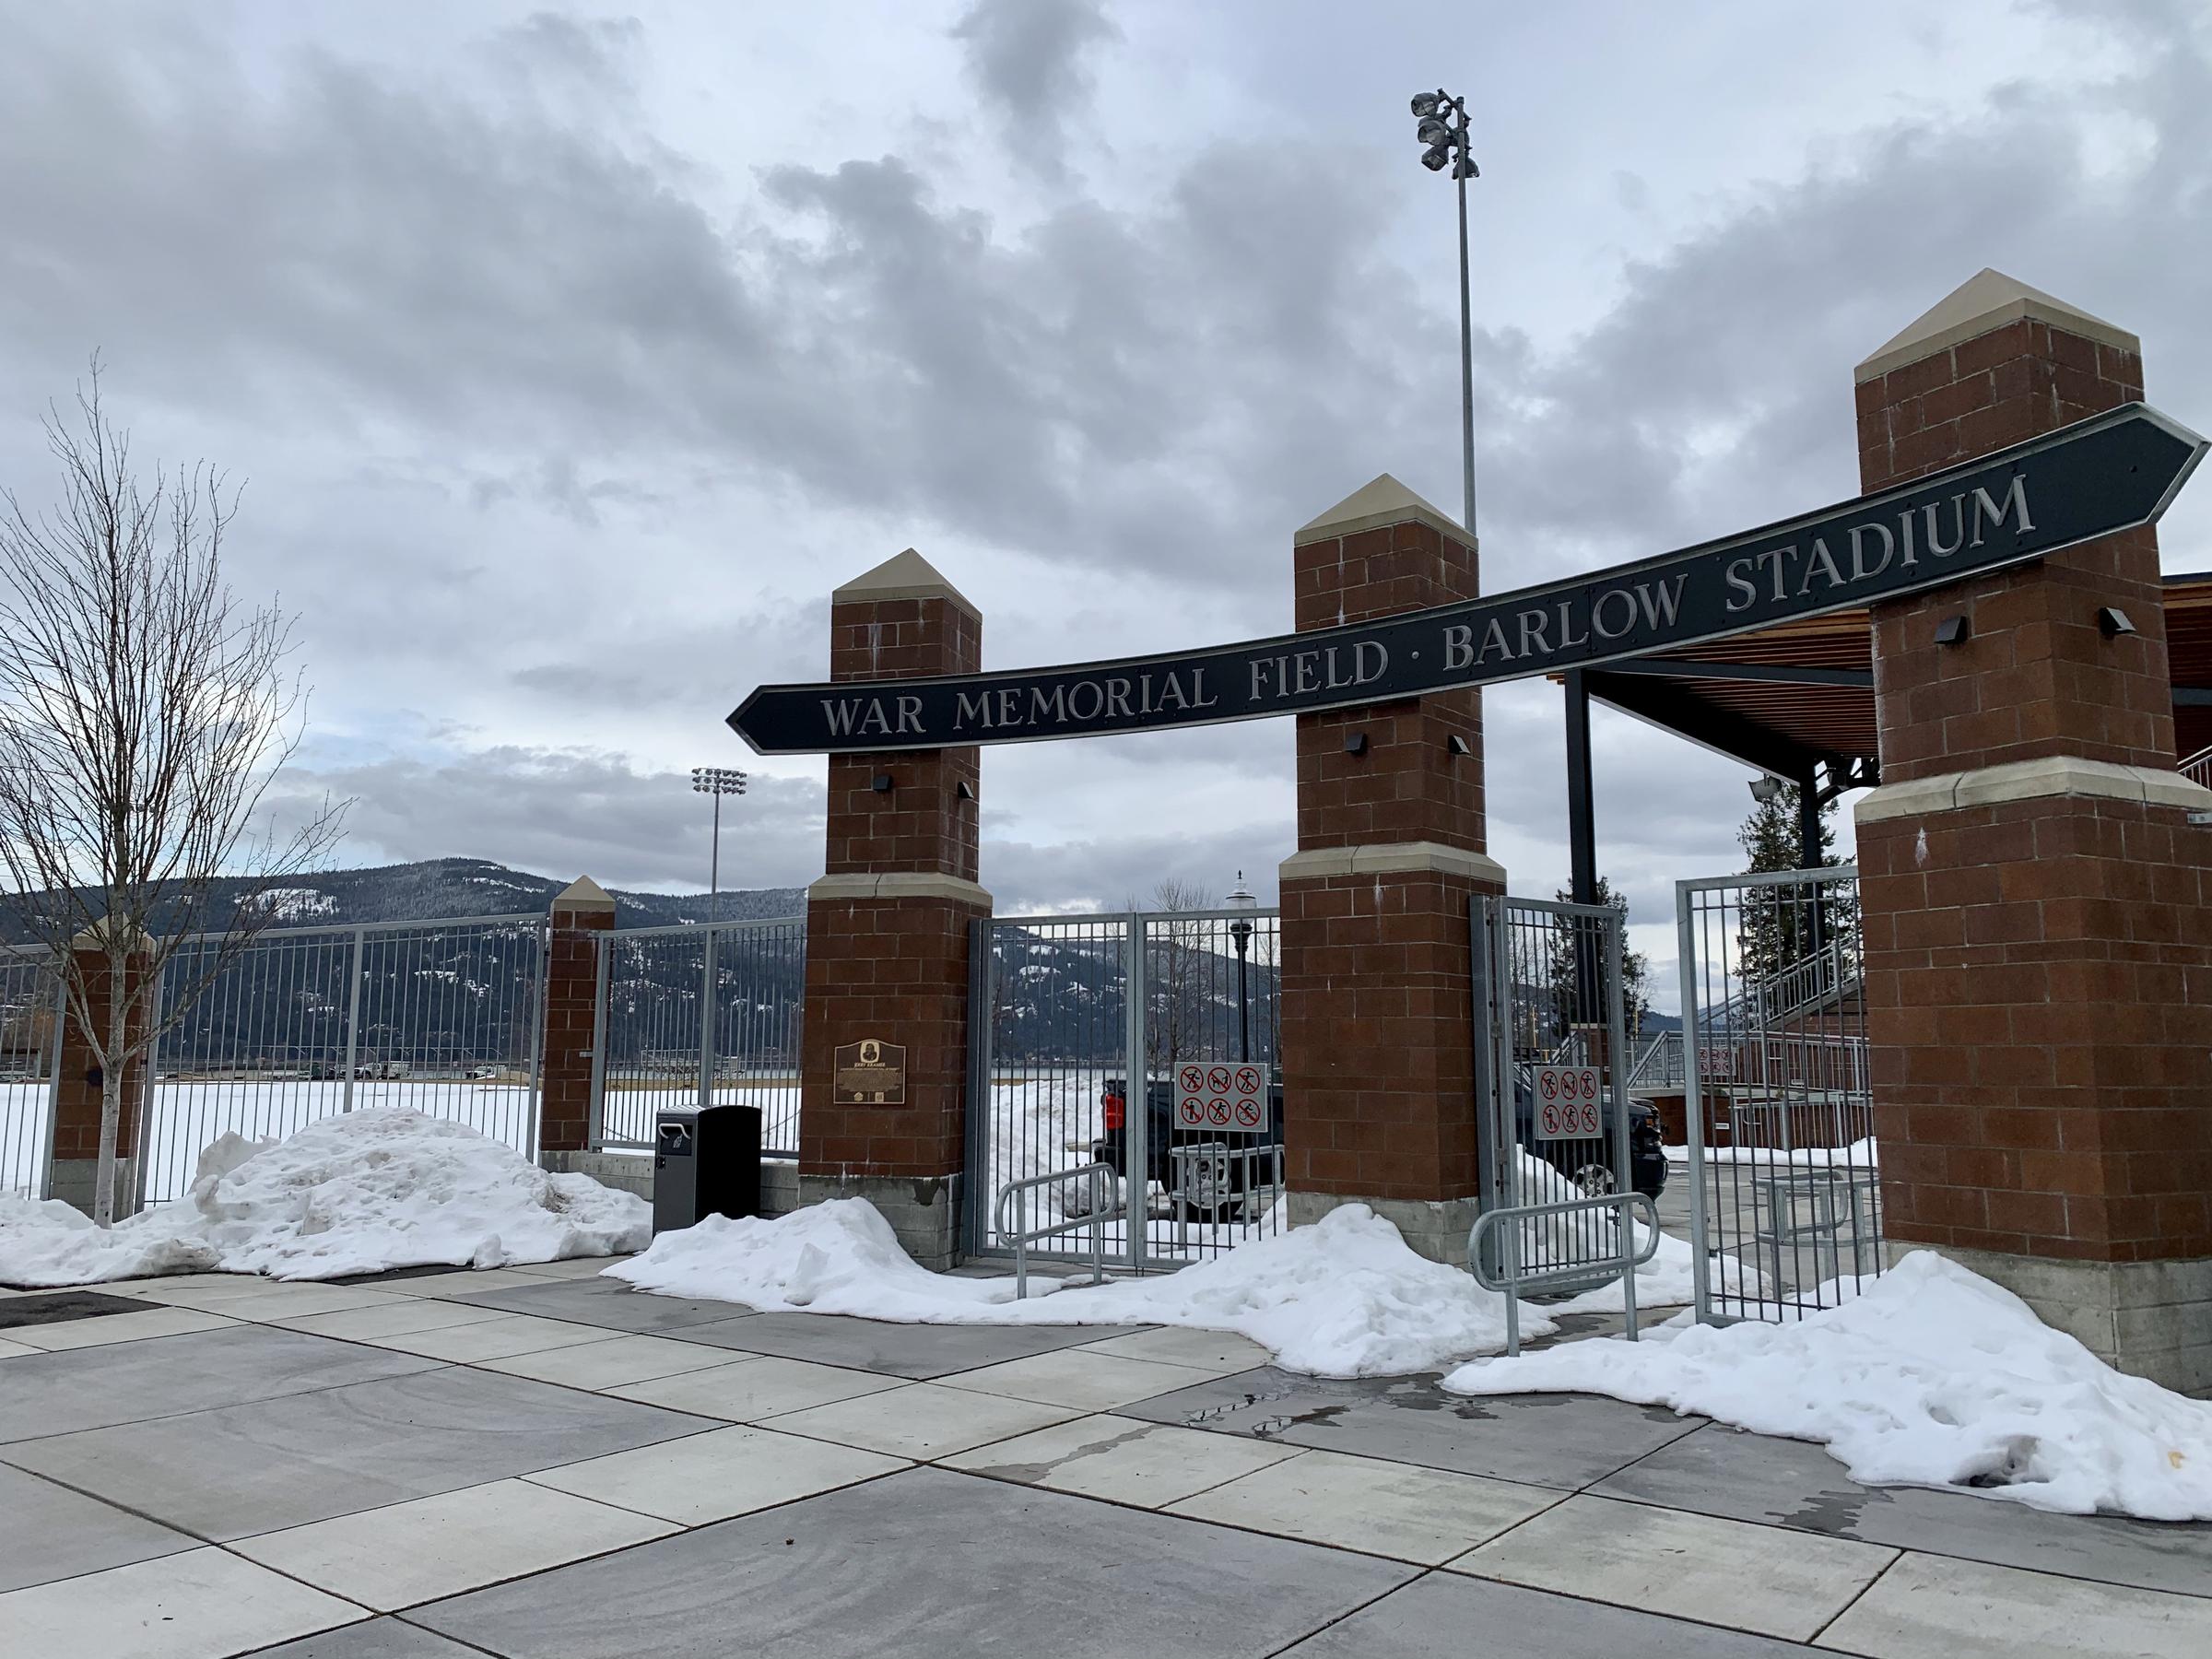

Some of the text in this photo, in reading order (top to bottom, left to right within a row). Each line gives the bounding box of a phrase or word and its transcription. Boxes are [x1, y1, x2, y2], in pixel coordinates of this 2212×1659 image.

[820, 697, 926, 736] WAR
[953, 668, 1218, 730] MEMORIAL
[1249, 641, 1390, 700] FIELD
[1442, 573, 1688, 671] BARLOW
[1725, 474, 2036, 612] STADIUM
